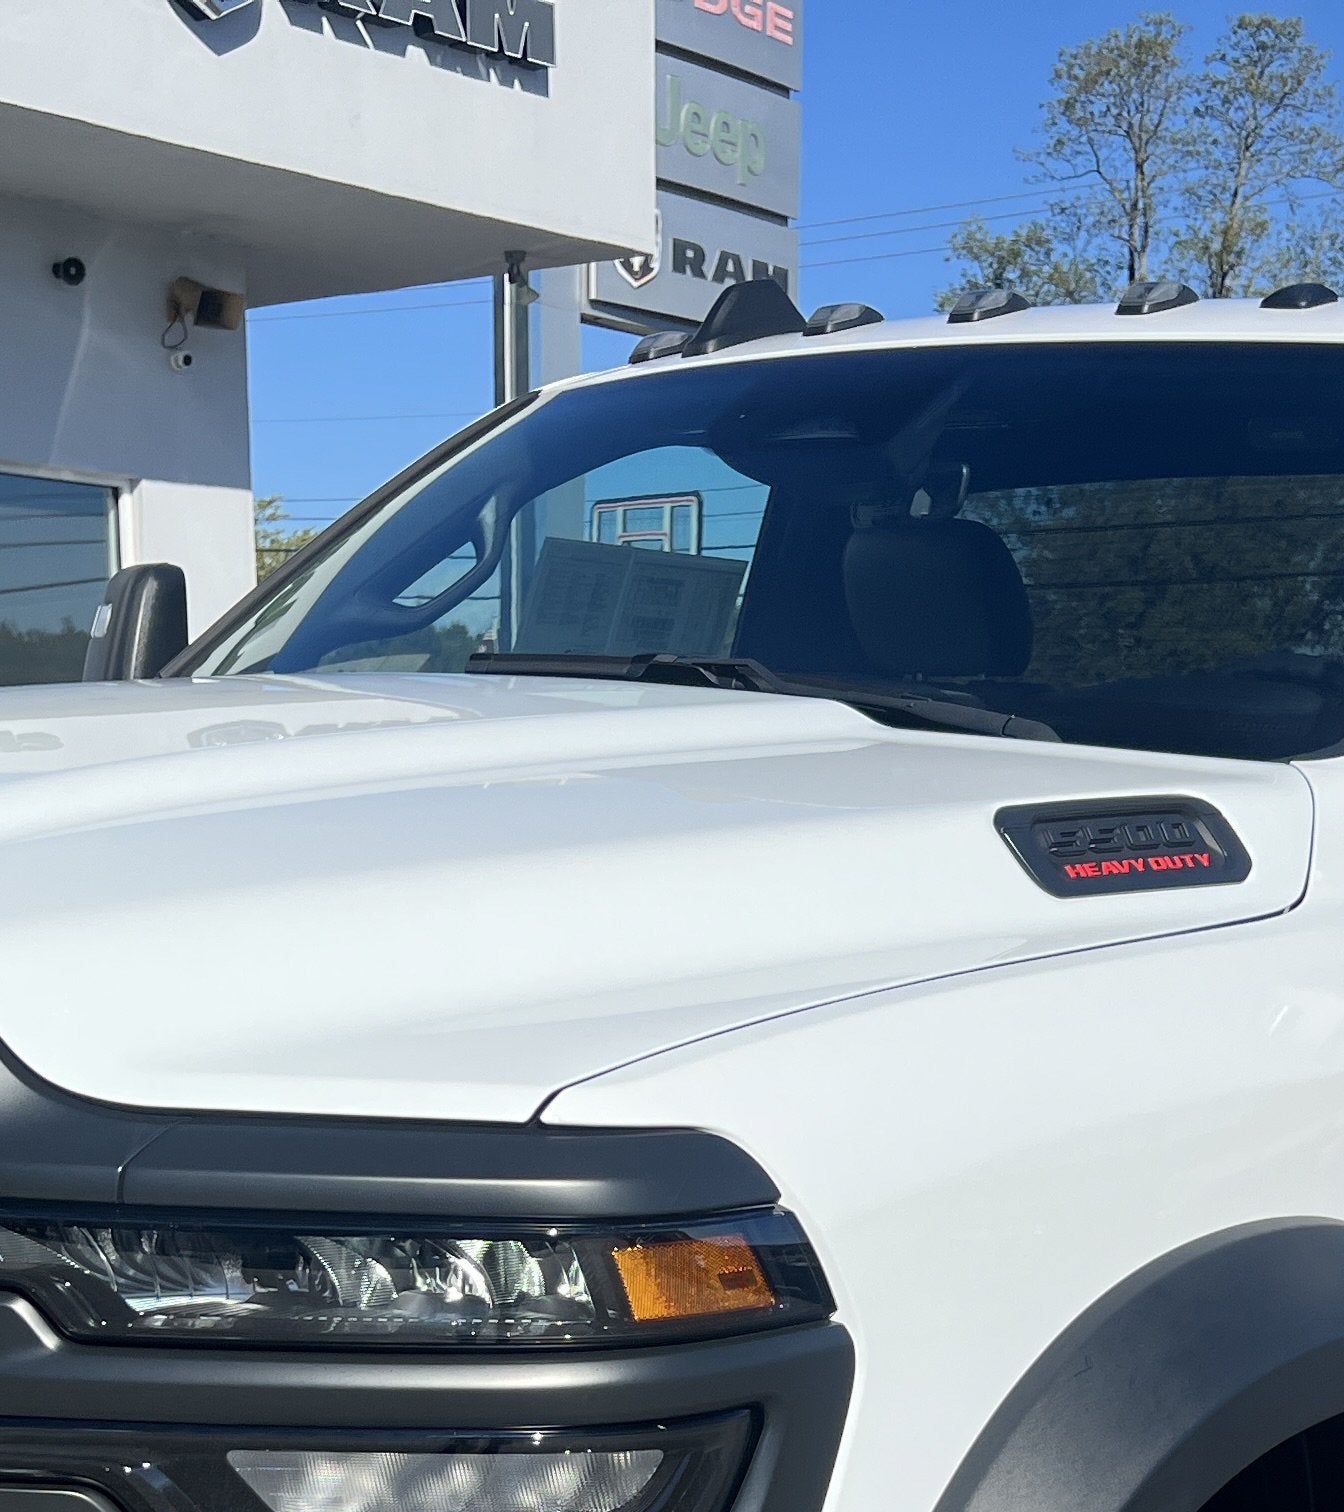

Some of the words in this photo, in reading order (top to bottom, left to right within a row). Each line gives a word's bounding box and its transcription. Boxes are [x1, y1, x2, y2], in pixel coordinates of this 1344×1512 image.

[656, 73, 767, 187] Jeep
[671, 237, 790, 294] RAM
[1043, 820, 1196, 857] 5500
[1064, 857, 1146, 879] HEAVY
[1147, 853, 1210, 871] DUTY
